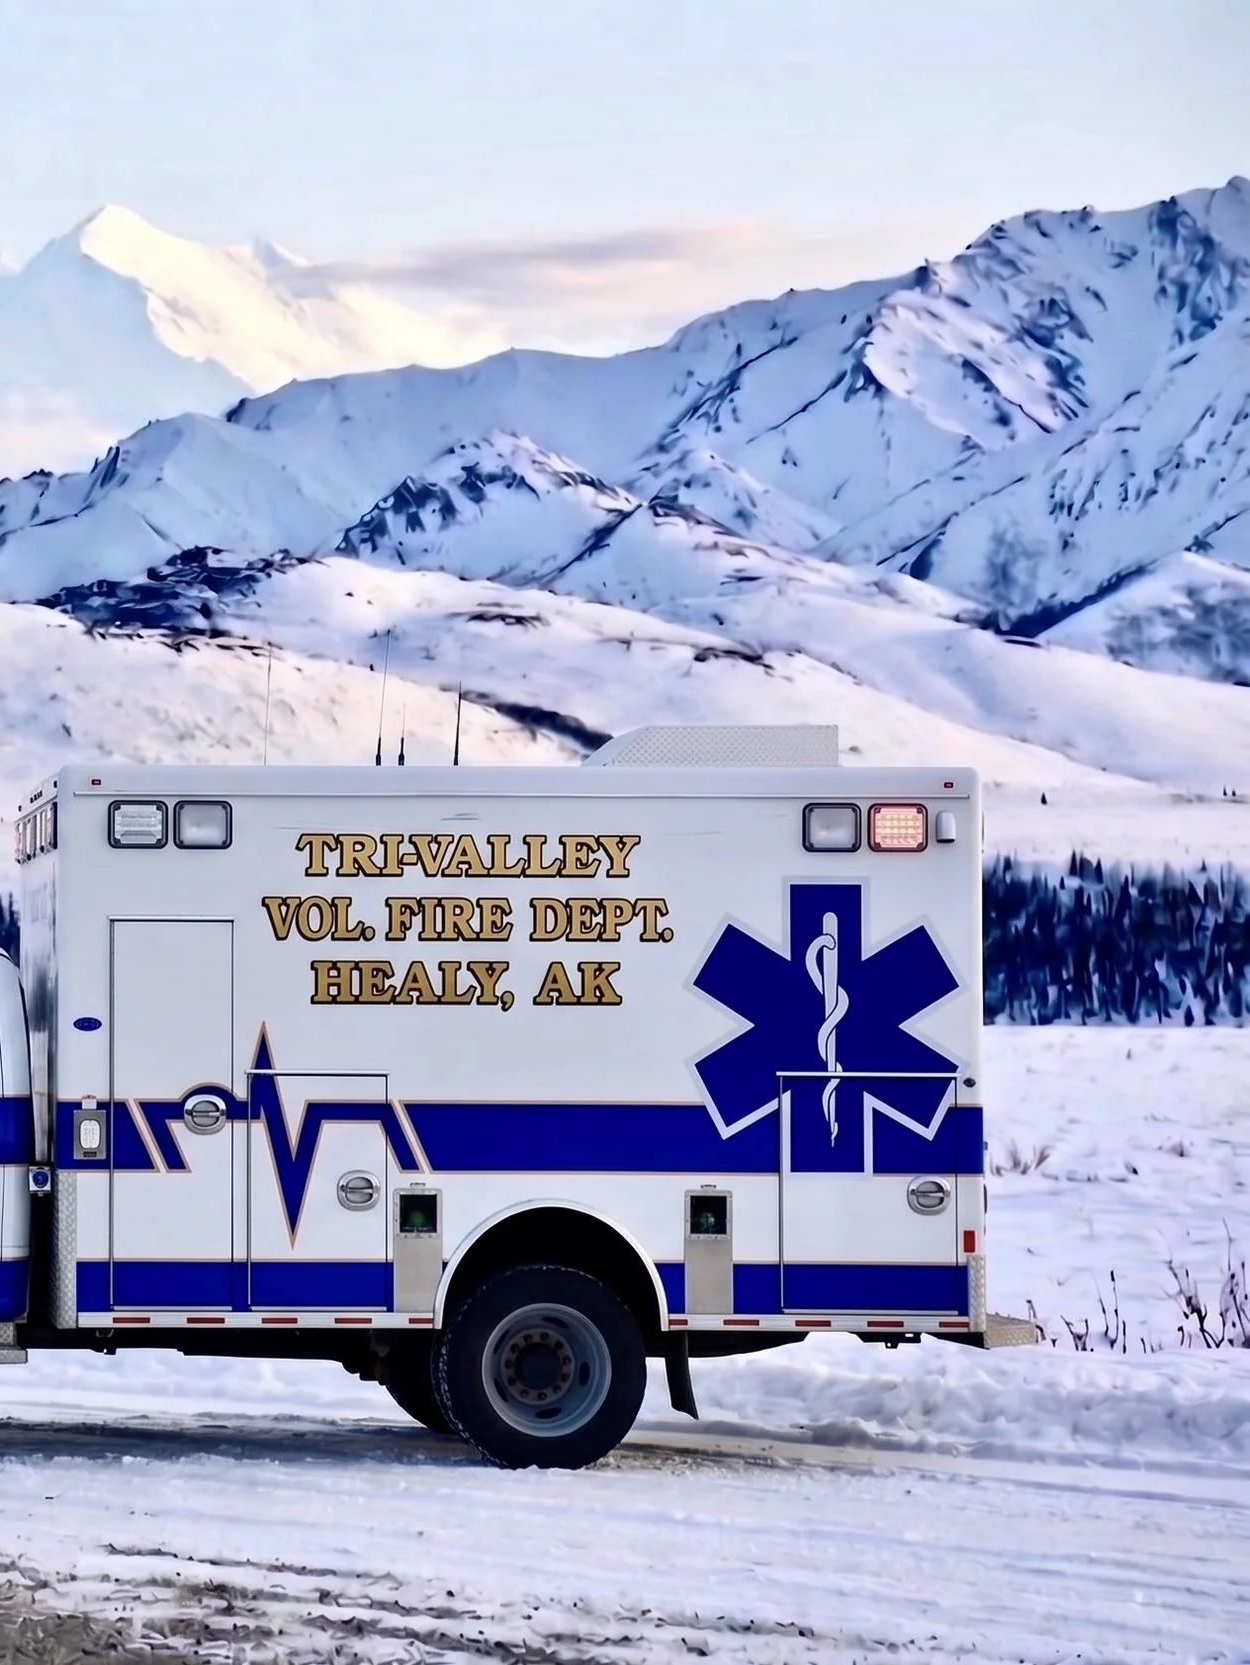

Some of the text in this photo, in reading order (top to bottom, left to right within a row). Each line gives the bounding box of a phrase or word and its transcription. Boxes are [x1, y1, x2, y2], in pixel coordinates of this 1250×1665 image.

[295, 833, 642, 878] TRI-VALLEY
[262, 896, 675, 943] VOL. FIRE DEPT.
[310, 960, 623, 1012] HEALY, AK
